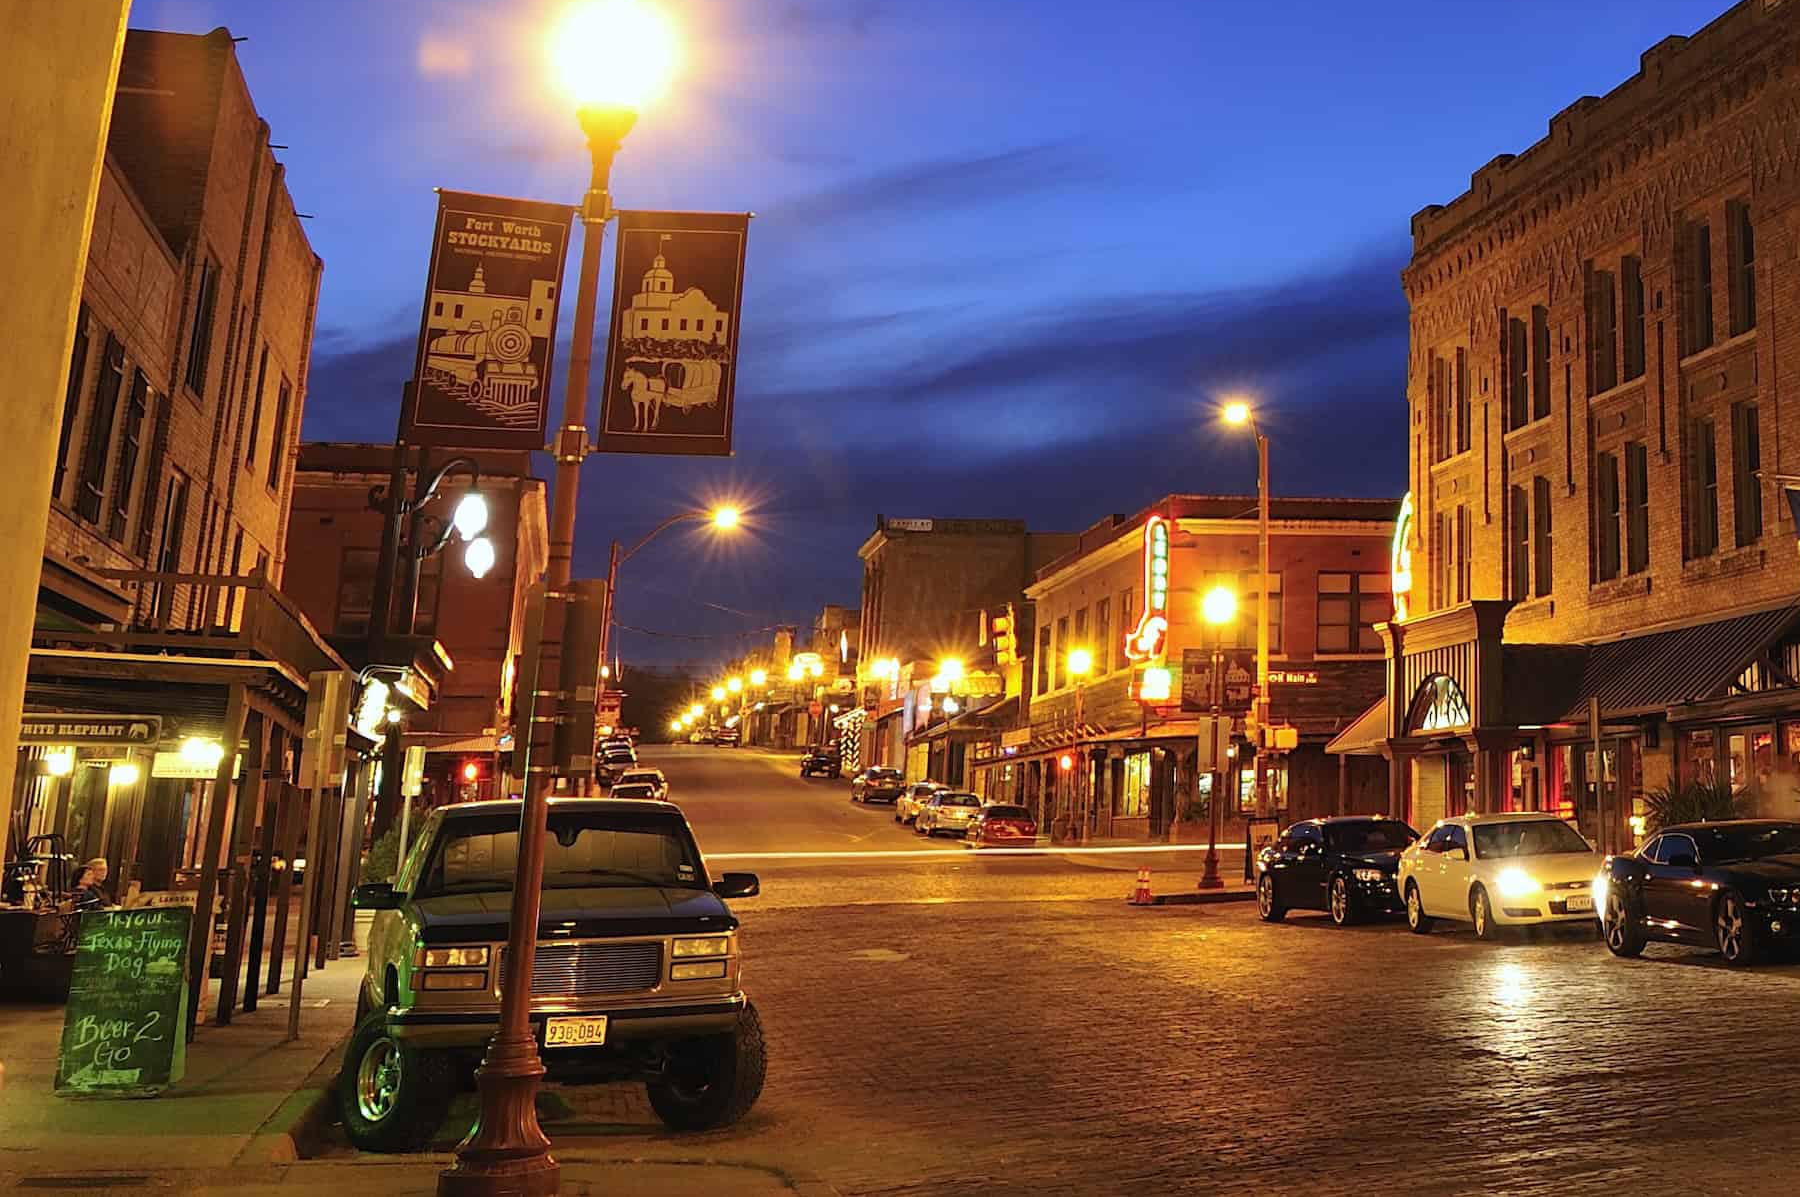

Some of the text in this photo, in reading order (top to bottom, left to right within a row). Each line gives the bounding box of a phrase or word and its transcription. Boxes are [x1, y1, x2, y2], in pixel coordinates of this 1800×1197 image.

[465, 217, 542, 238] Fort Worth
[447, 231, 553, 254] STOCKYARDS
[21, 723, 125, 736] HITE ELEPHANT
[74, 1010, 164, 1050] Beer 2
[93, 1040, 131, 1069] Go
